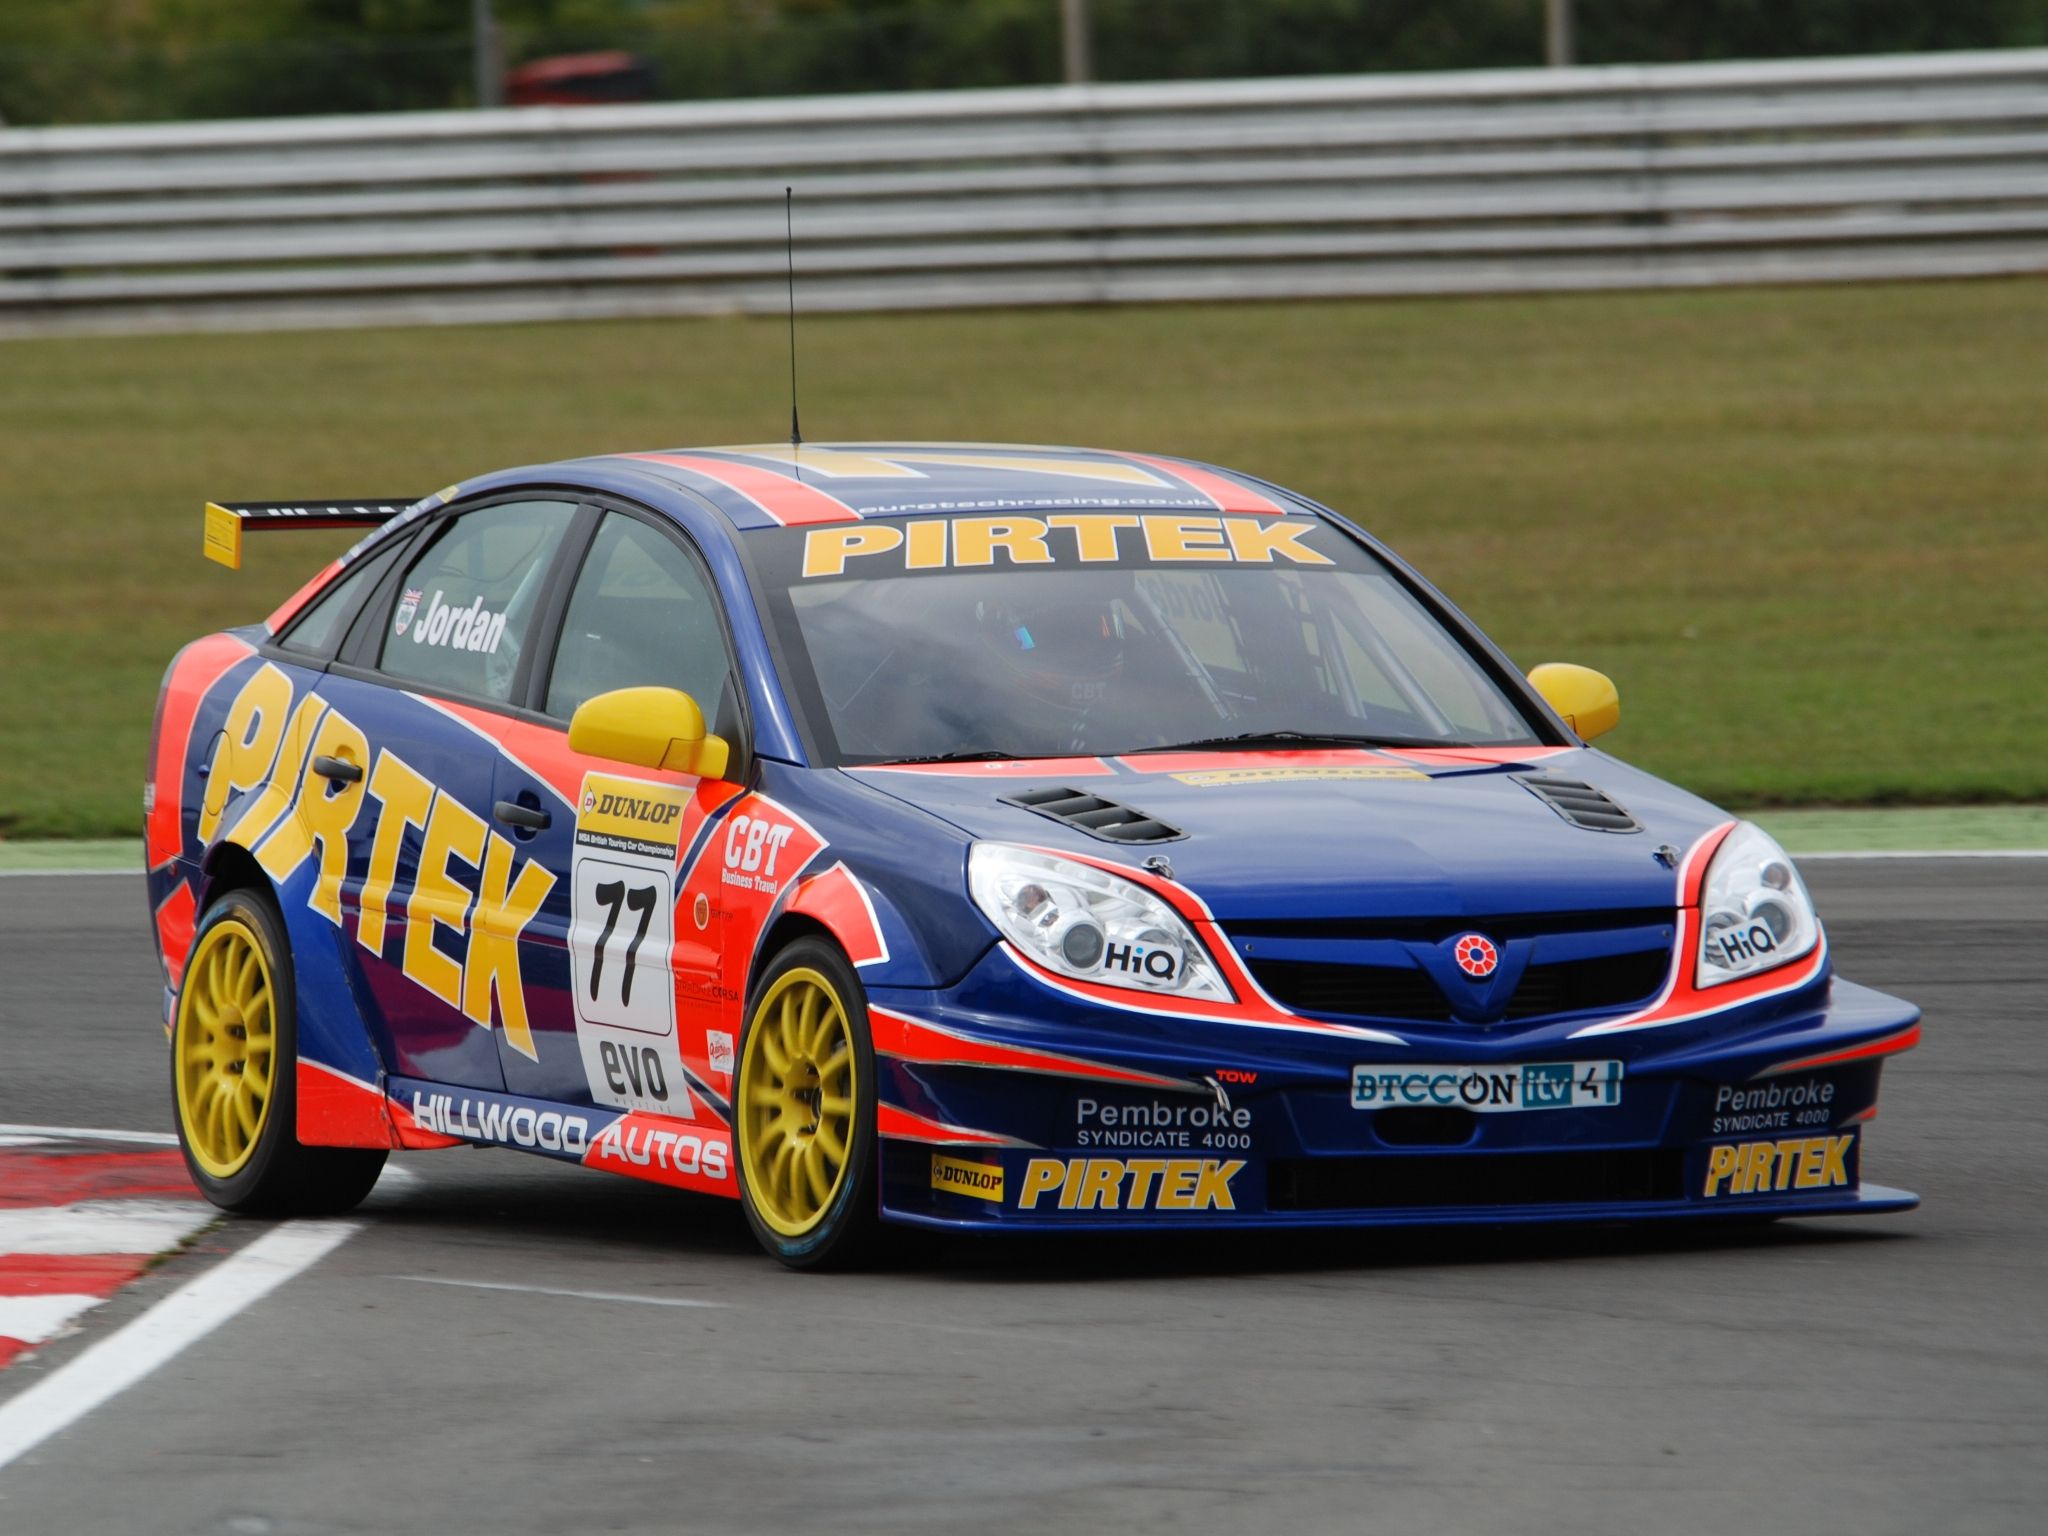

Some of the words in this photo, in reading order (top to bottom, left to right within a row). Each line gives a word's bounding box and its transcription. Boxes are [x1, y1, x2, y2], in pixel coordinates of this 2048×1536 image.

[858, 496, 1213, 514] eurotechracing.co.uk
[802, 514, 1336, 577] PIRTEK
[413, 590, 506, 654] Jordan
[597, 794, 680, 824] DUNLOP
[197, 661, 559, 1064] PIRTEK
[578, 832, 590, 842] MSA
[590, 834, 608, 845] British
[608, 837, 627, 851] Touring
[627, 841, 638, 850] Car
[638, 842, 674, 858] Championship
[725, 815, 794, 877] CBT
[721, 867, 753, 889] Business
[755, 875, 778, 894] Travel
[590, 880, 657, 1008] 77
[1105, 942, 1176, 980] HiQ
[1720, 926, 1776, 963] HiQ
[600, 1040, 668, 1101] evo
[1215, 1070, 1257, 1083] TOW
[1527, 1071, 1569, 1101] itv
[1580, 1067, 1599, 1099] 4
[1077, 1099, 1251, 1129] Pembroke
[1715, 1080, 1835, 1113] Pembroke
[413, 1091, 588, 1155] HILLWOOD
[601, 1124, 727, 1179] AUTOS
[1712, 1112, 1790, 1133] SYNDICATE
[1796, 1109, 1830, 1124] 4000
[1077, 1131, 1190, 1147] SYNDICATE
[1202, 1133, 1250, 1149] 4000
[943, 1166, 1003, 1191] DUNLOP
[1704, 1134, 1855, 1198] PIRTEK
[1018, 1159, 1248, 1210] PIRTEK
